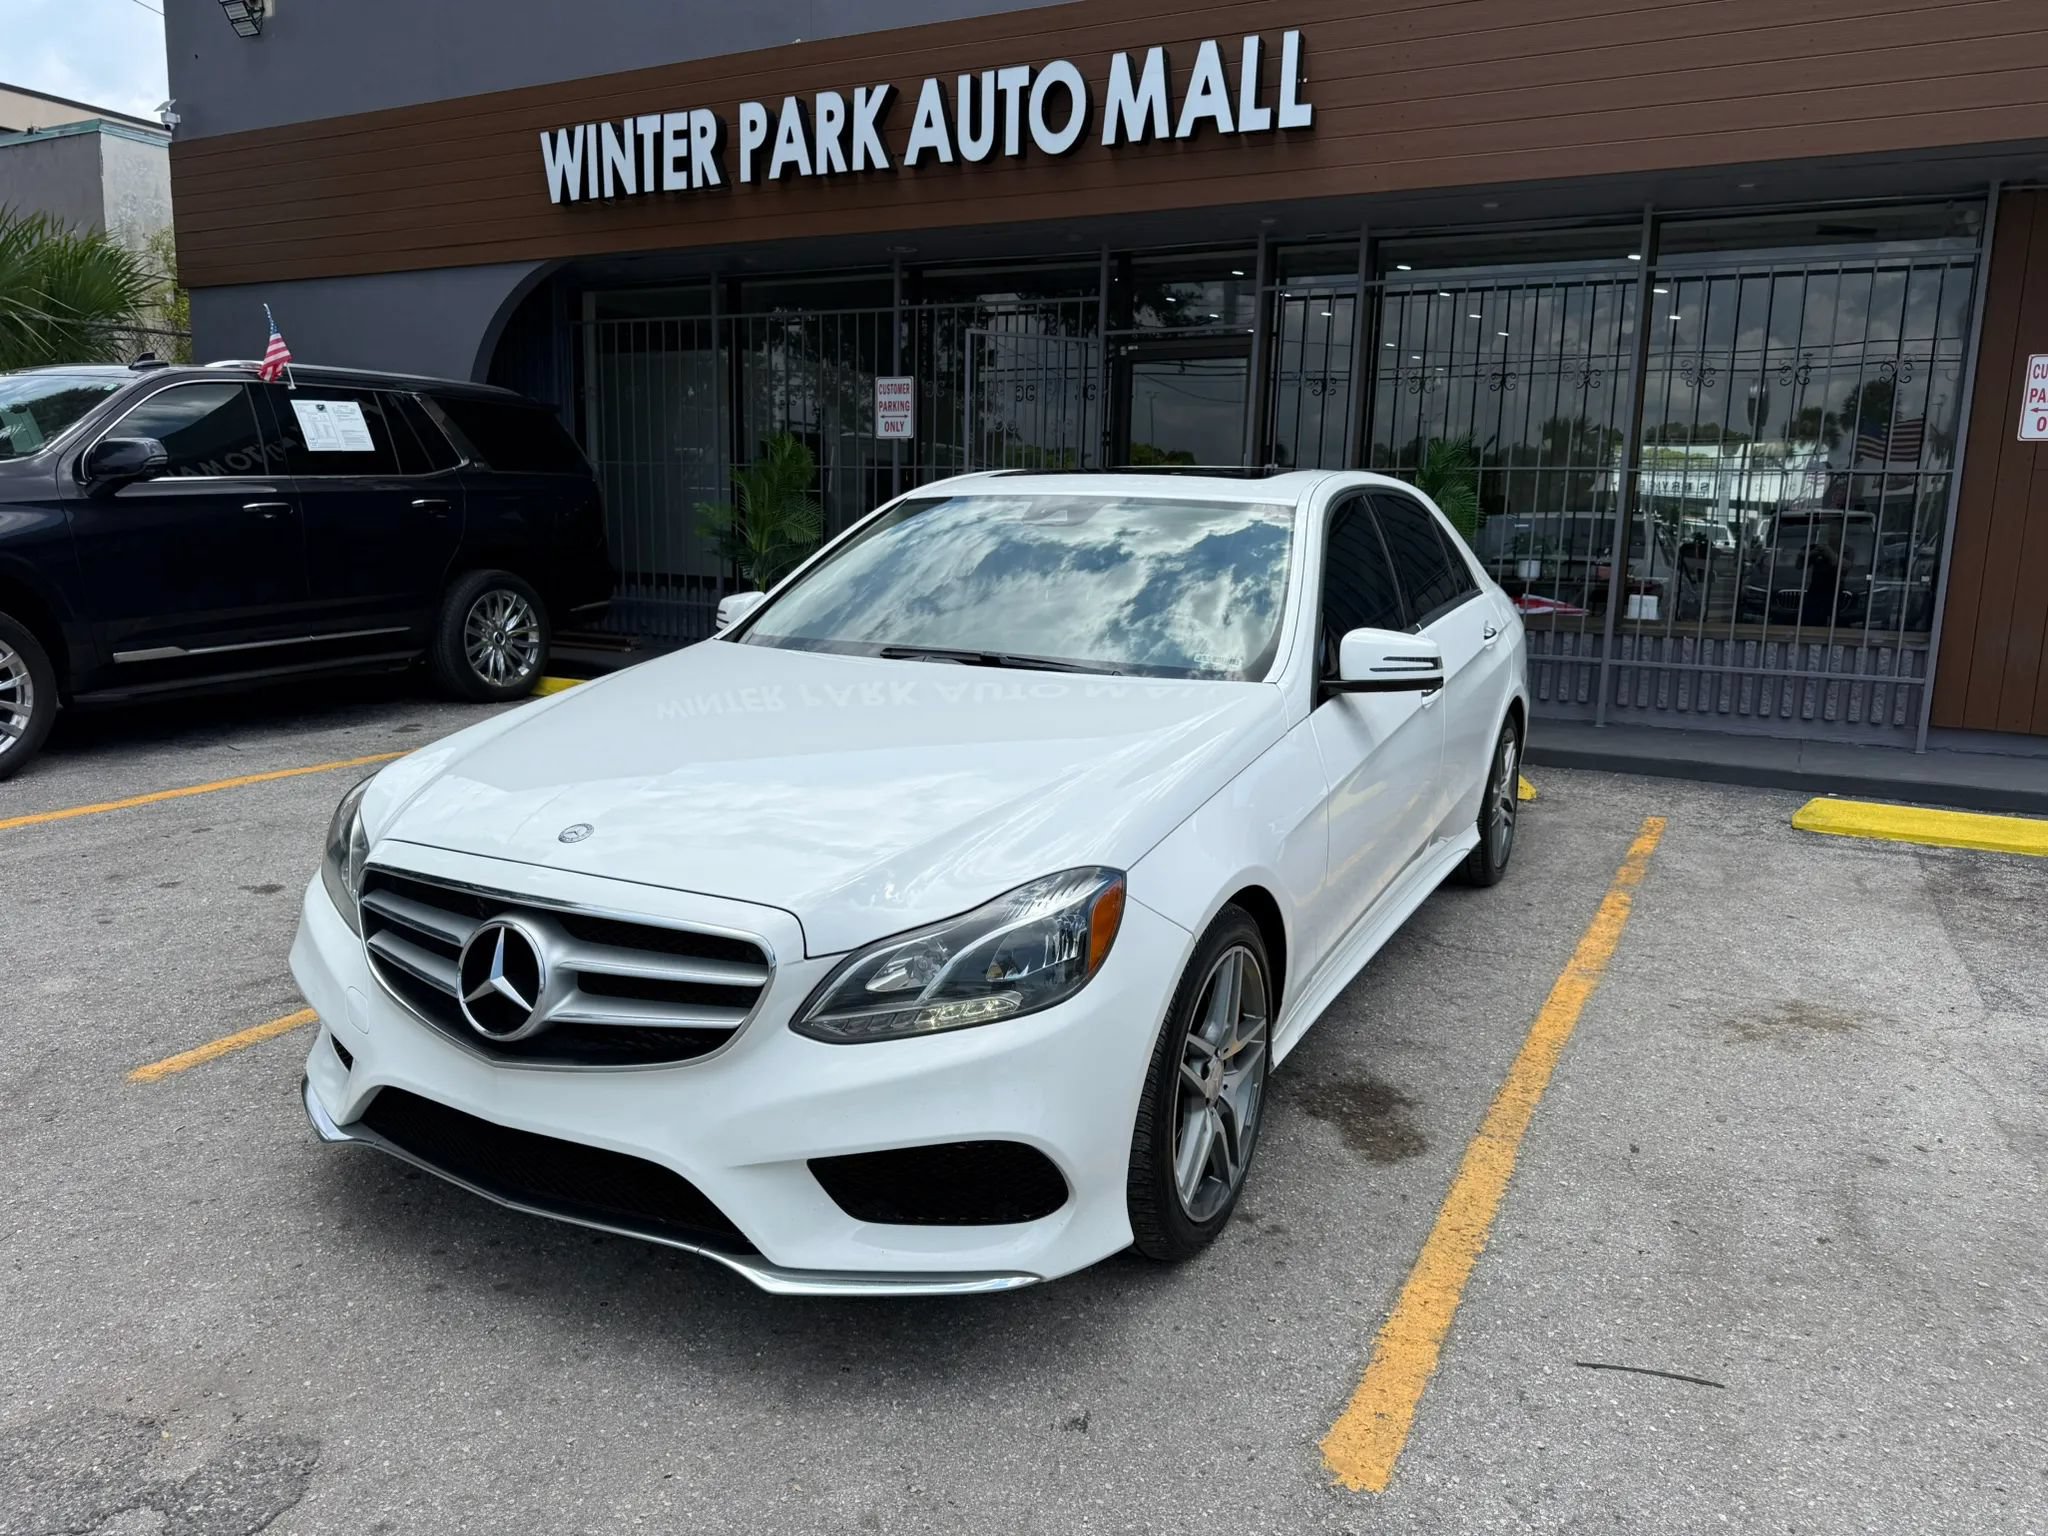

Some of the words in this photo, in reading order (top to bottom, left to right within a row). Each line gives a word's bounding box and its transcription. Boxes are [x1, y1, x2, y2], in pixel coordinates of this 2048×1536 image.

[541, 110, 721, 203] WINTER
[740, 85, 890, 182] PARK
[904, 61, 1086, 164] AUTO
[1102, 30, 1313, 145] MALL
[878, 383, 911, 395] CUSTOMER
[2028, 387, 2048, 404] PA
[878, 400, 911, 412] PARKING
[884, 420, 905, 433] ONLY
